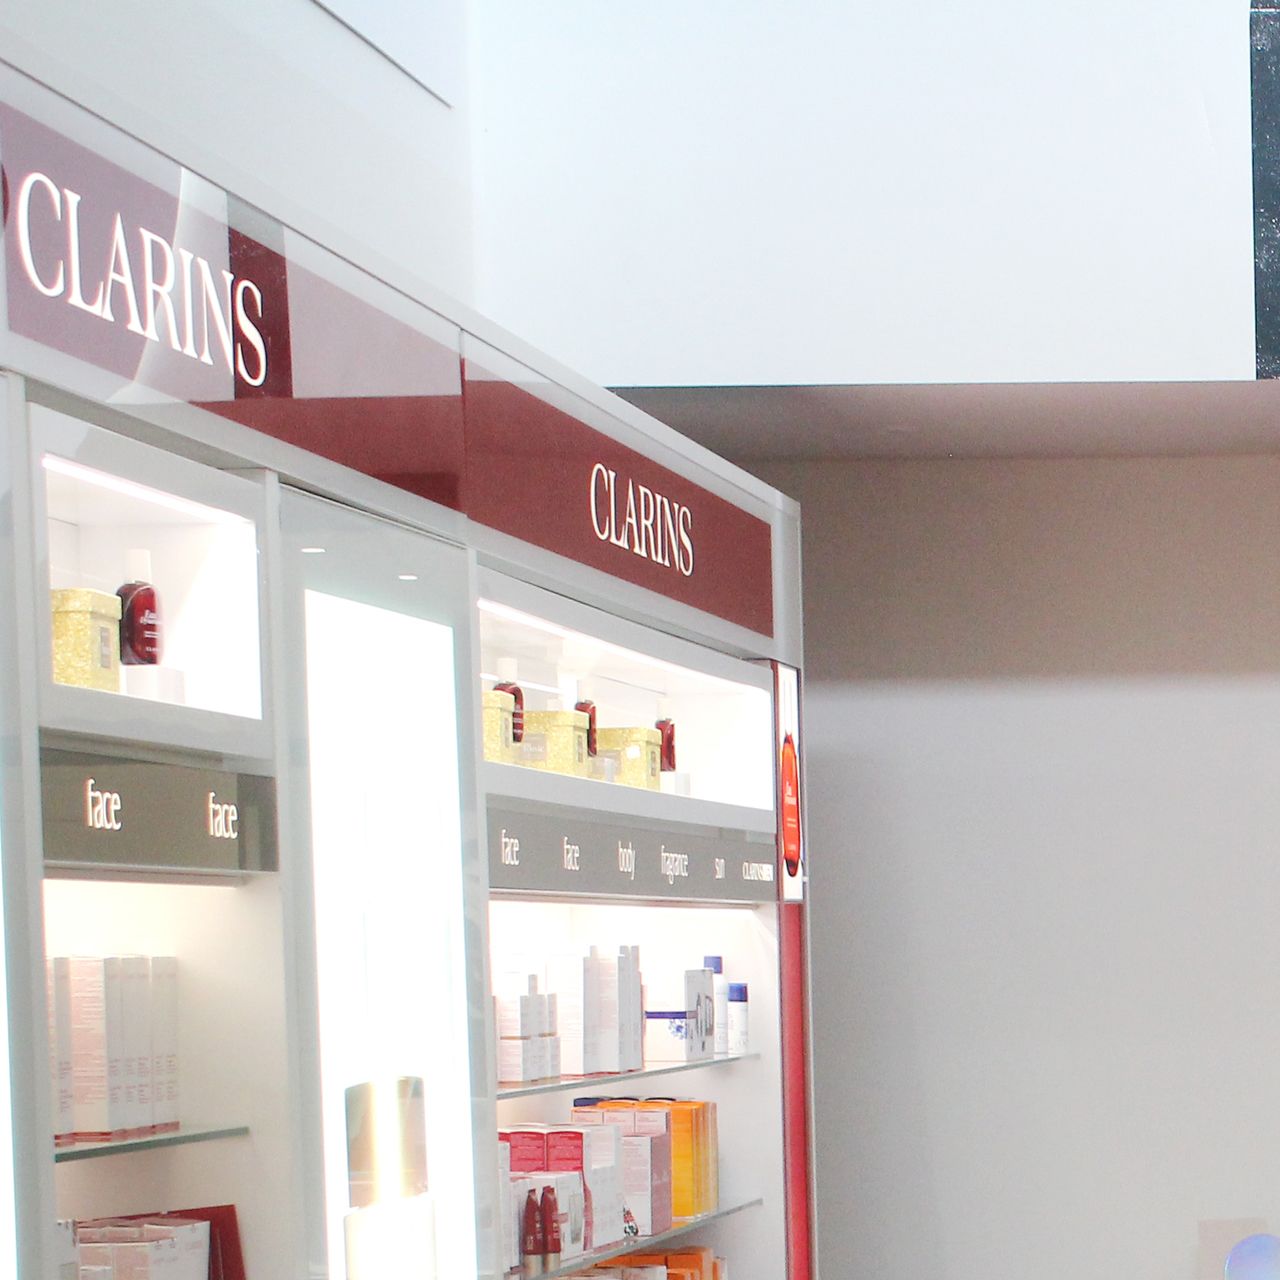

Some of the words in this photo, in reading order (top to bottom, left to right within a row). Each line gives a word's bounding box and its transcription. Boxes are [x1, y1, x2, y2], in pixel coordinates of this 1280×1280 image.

[17, 171, 268, 387] CLARINS
[590, 463, 694, 576] CLARINS
[87, 778, 122, 830] face
[207, 791, 238, 839] face
[501, 829, 520, 866] face
[563, 837, 580, 871] face
[618, 840, 636, 880] body
[660, 845, 688, 884] fragrance
